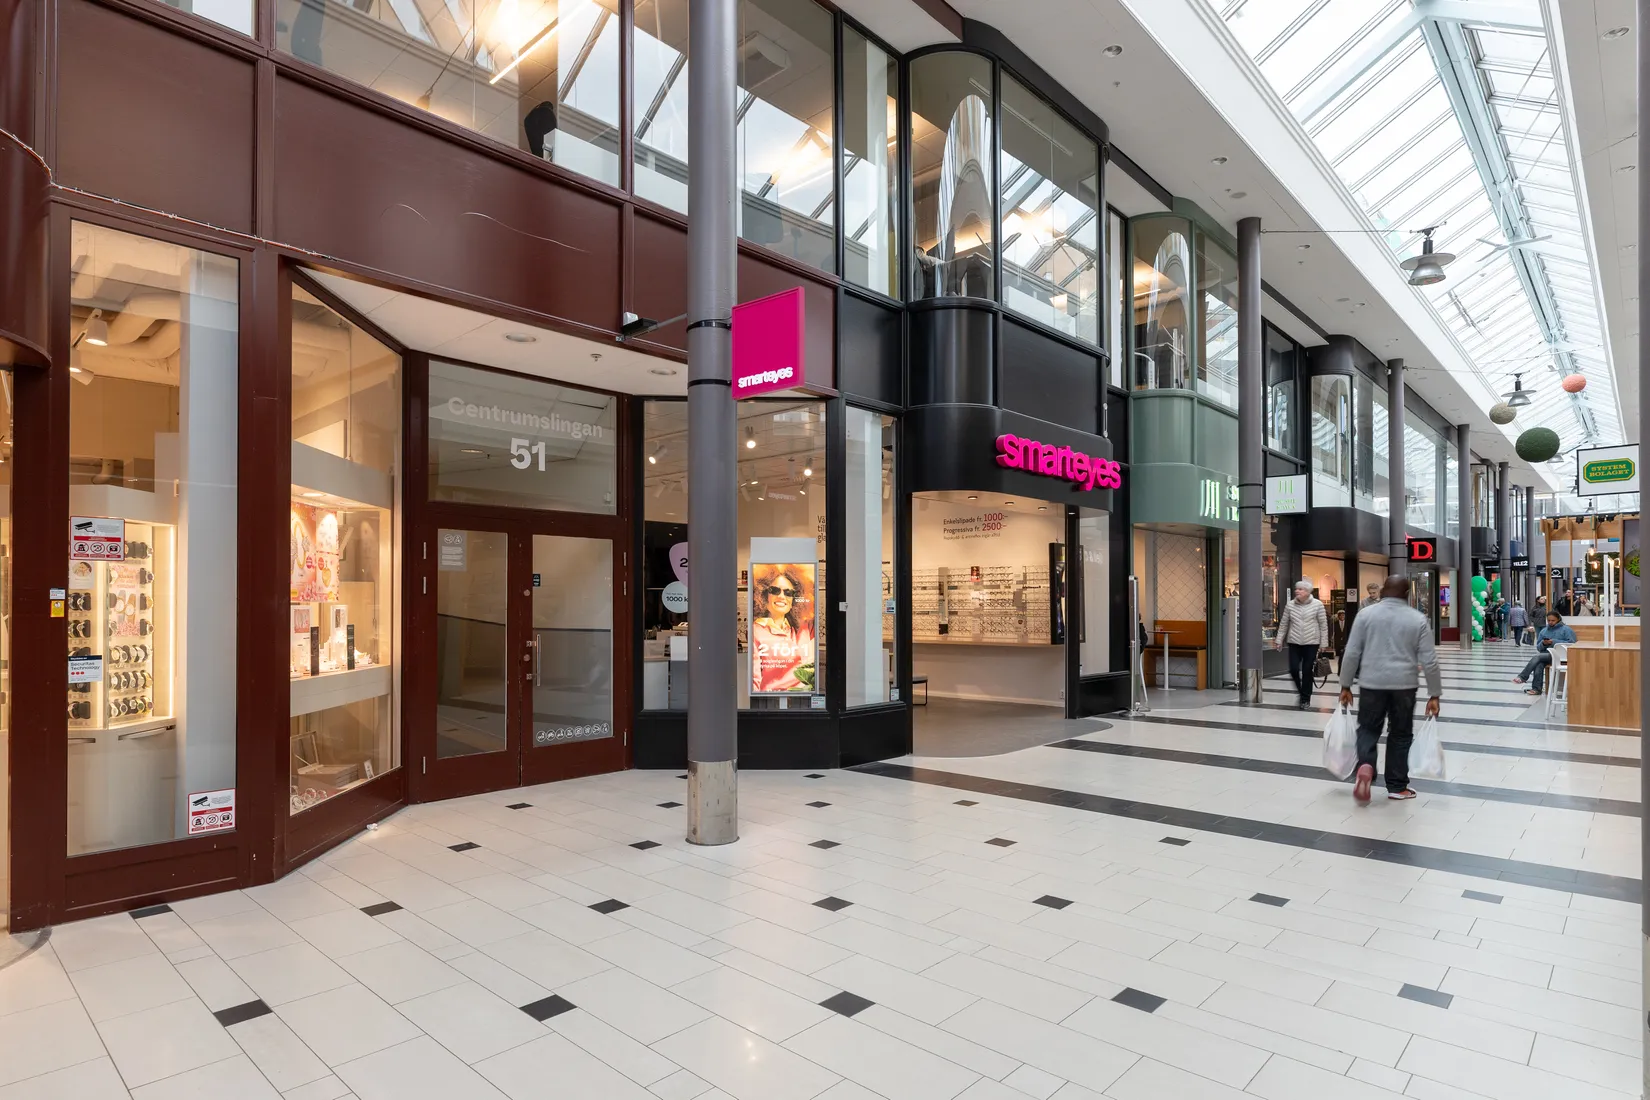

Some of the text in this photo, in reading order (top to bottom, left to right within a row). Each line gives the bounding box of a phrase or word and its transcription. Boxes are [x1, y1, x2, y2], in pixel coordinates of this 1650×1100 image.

[738, 367, 794, 388] smarteyes
[448, 397, 603, 439] Centrumslingan
[510, 437, 546, 472] 51
[996, 434, 1122, 491] smarteyes
[1591, 464, 1627, 472] SYSTEM
[1589, 469, 1630, 477] BOLAGET
[943, 516, 976, 525] Enkelslipade
[943, 526, 974, 535] Progressiva
[758, 642, 808, 657] 2 för 1
